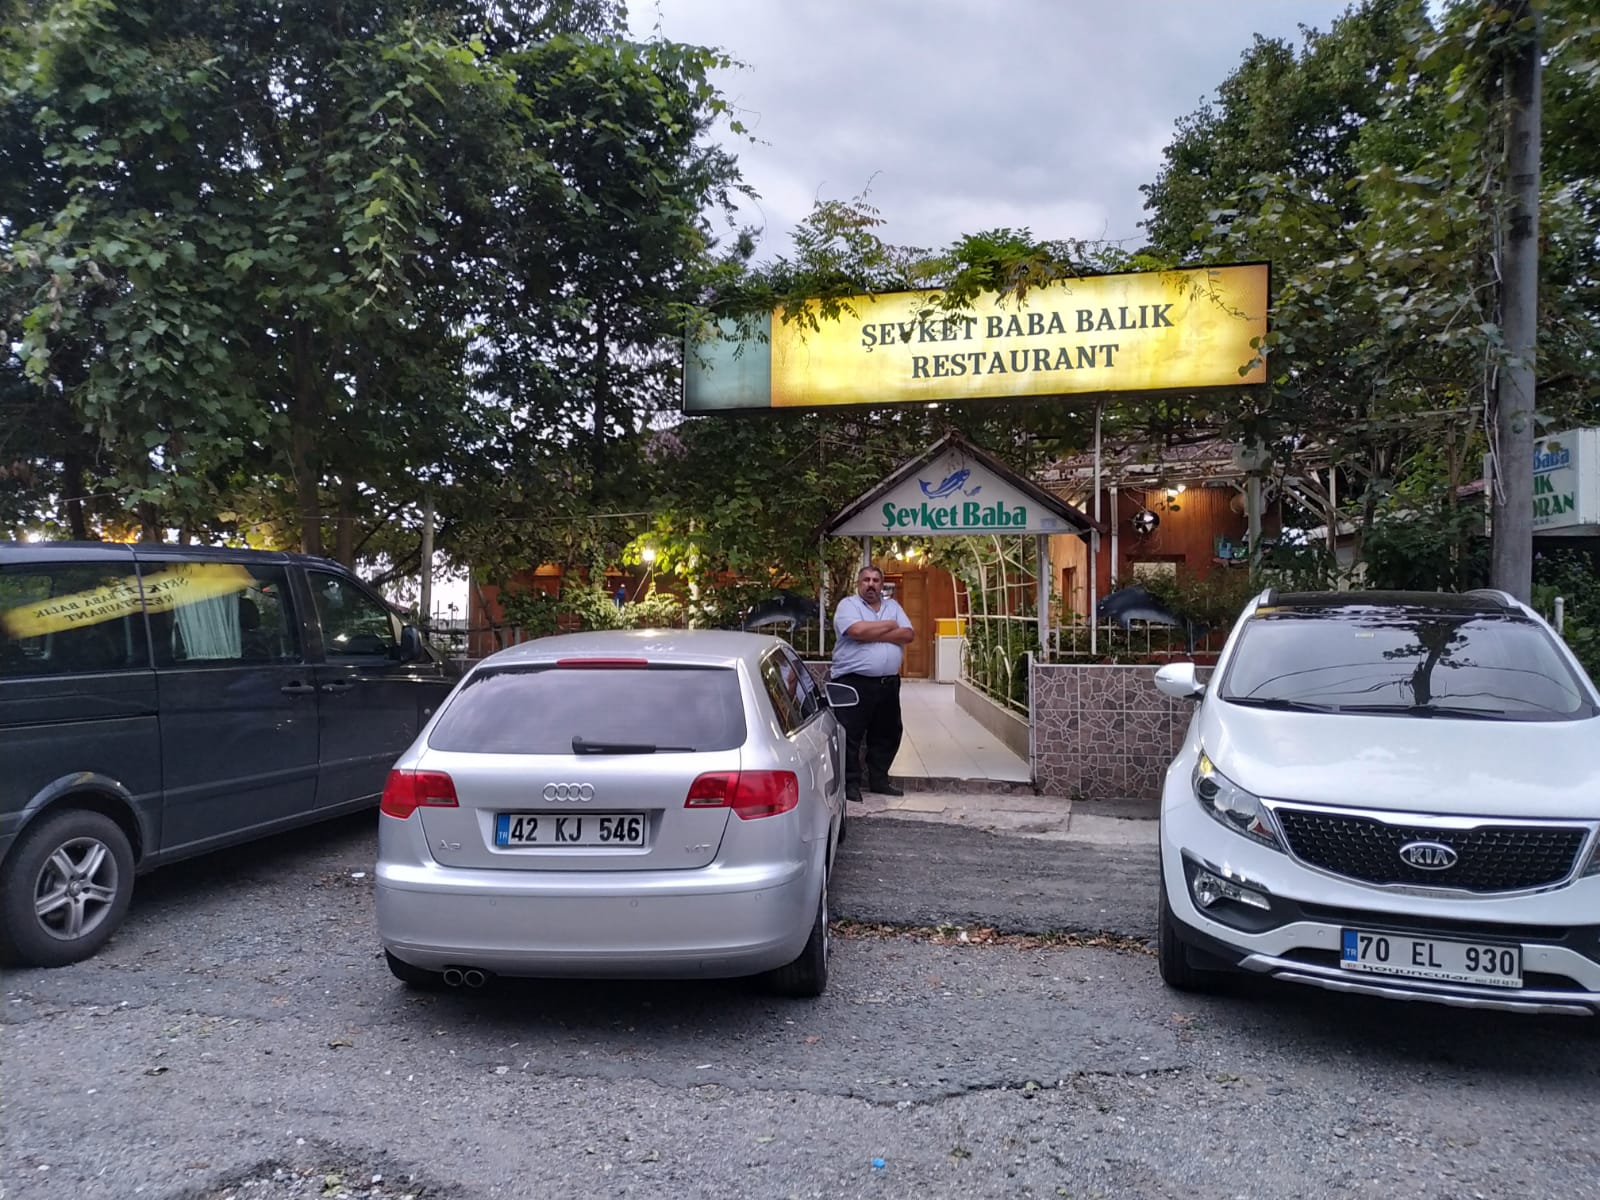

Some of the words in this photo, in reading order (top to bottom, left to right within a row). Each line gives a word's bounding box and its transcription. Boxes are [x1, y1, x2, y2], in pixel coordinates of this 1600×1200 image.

[862, 316, 977, 353] ŞEVKET
[986, 311, 1066, 339] BABA
[1075, 303, 1174, 333] BALIK
[912, 343, 1119, 379] RESTAURANT
[881, 502, 958, 531] Şevket
[963, 501, 1027, 528] Baba
[511, 817, 538, 842] 42
[555, 817, 582, 842] KJ
[599, 817, 641, 842] 546
[1410, 847, 1449, 864] KIA
[1346, 947, 1357, 957] TR
[1360, 935, 1390, 962] 70
[1412, 941, 1442, 968] EL
[1465, 946, 1515, 976] 930
